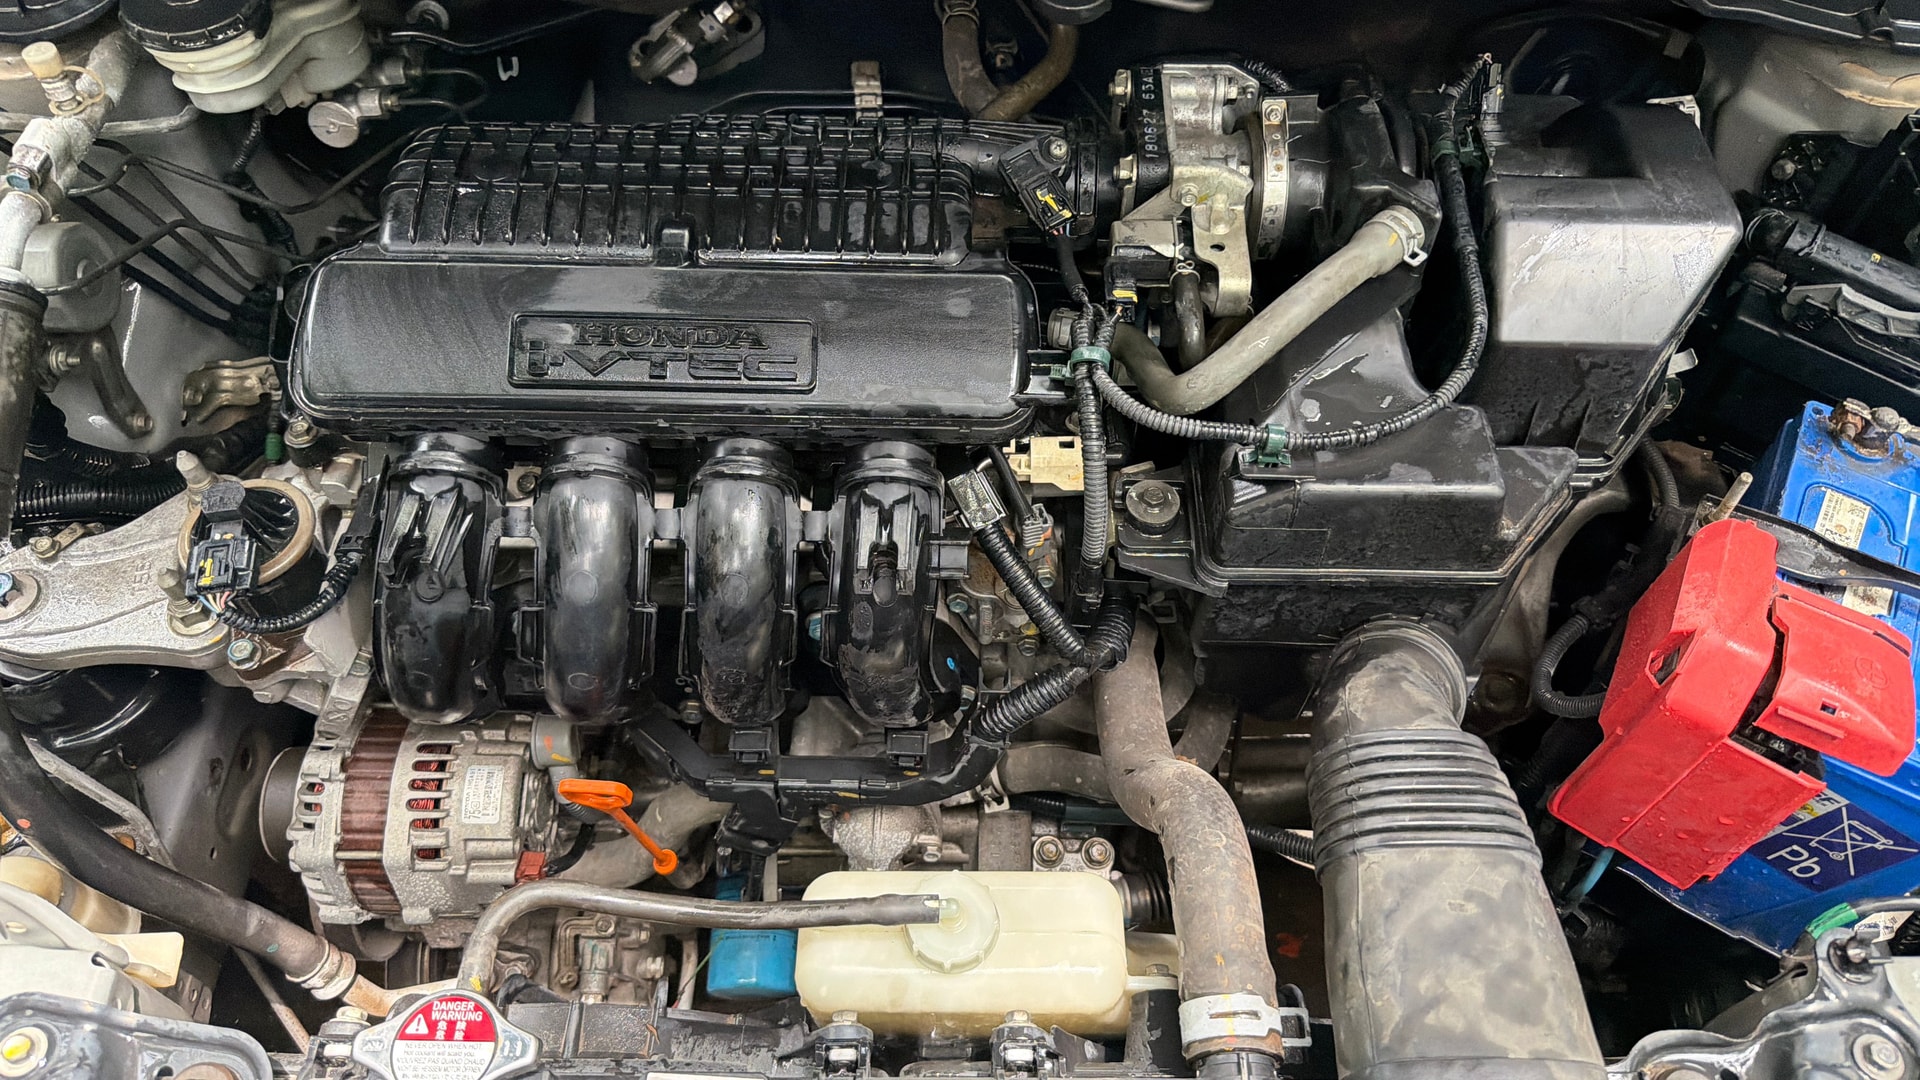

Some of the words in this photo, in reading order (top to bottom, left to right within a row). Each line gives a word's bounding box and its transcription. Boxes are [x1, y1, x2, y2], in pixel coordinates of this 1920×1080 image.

[1142, 109, 1160, 158] 180627
[572, 322, 769, 350] HONDA
[527, 339, 798, 382] i-VTEC
[1766, 844, 1821, 878] Pb
[431, 1010, 483, 1021] WARNUNG
[433, 1001, 475, 1011] DANGER
[503, 1039, 523, 1057] 1.1
[427, 1057, 440, 1065] PAS
[463, 1058, 486, 1066] CHAUD
